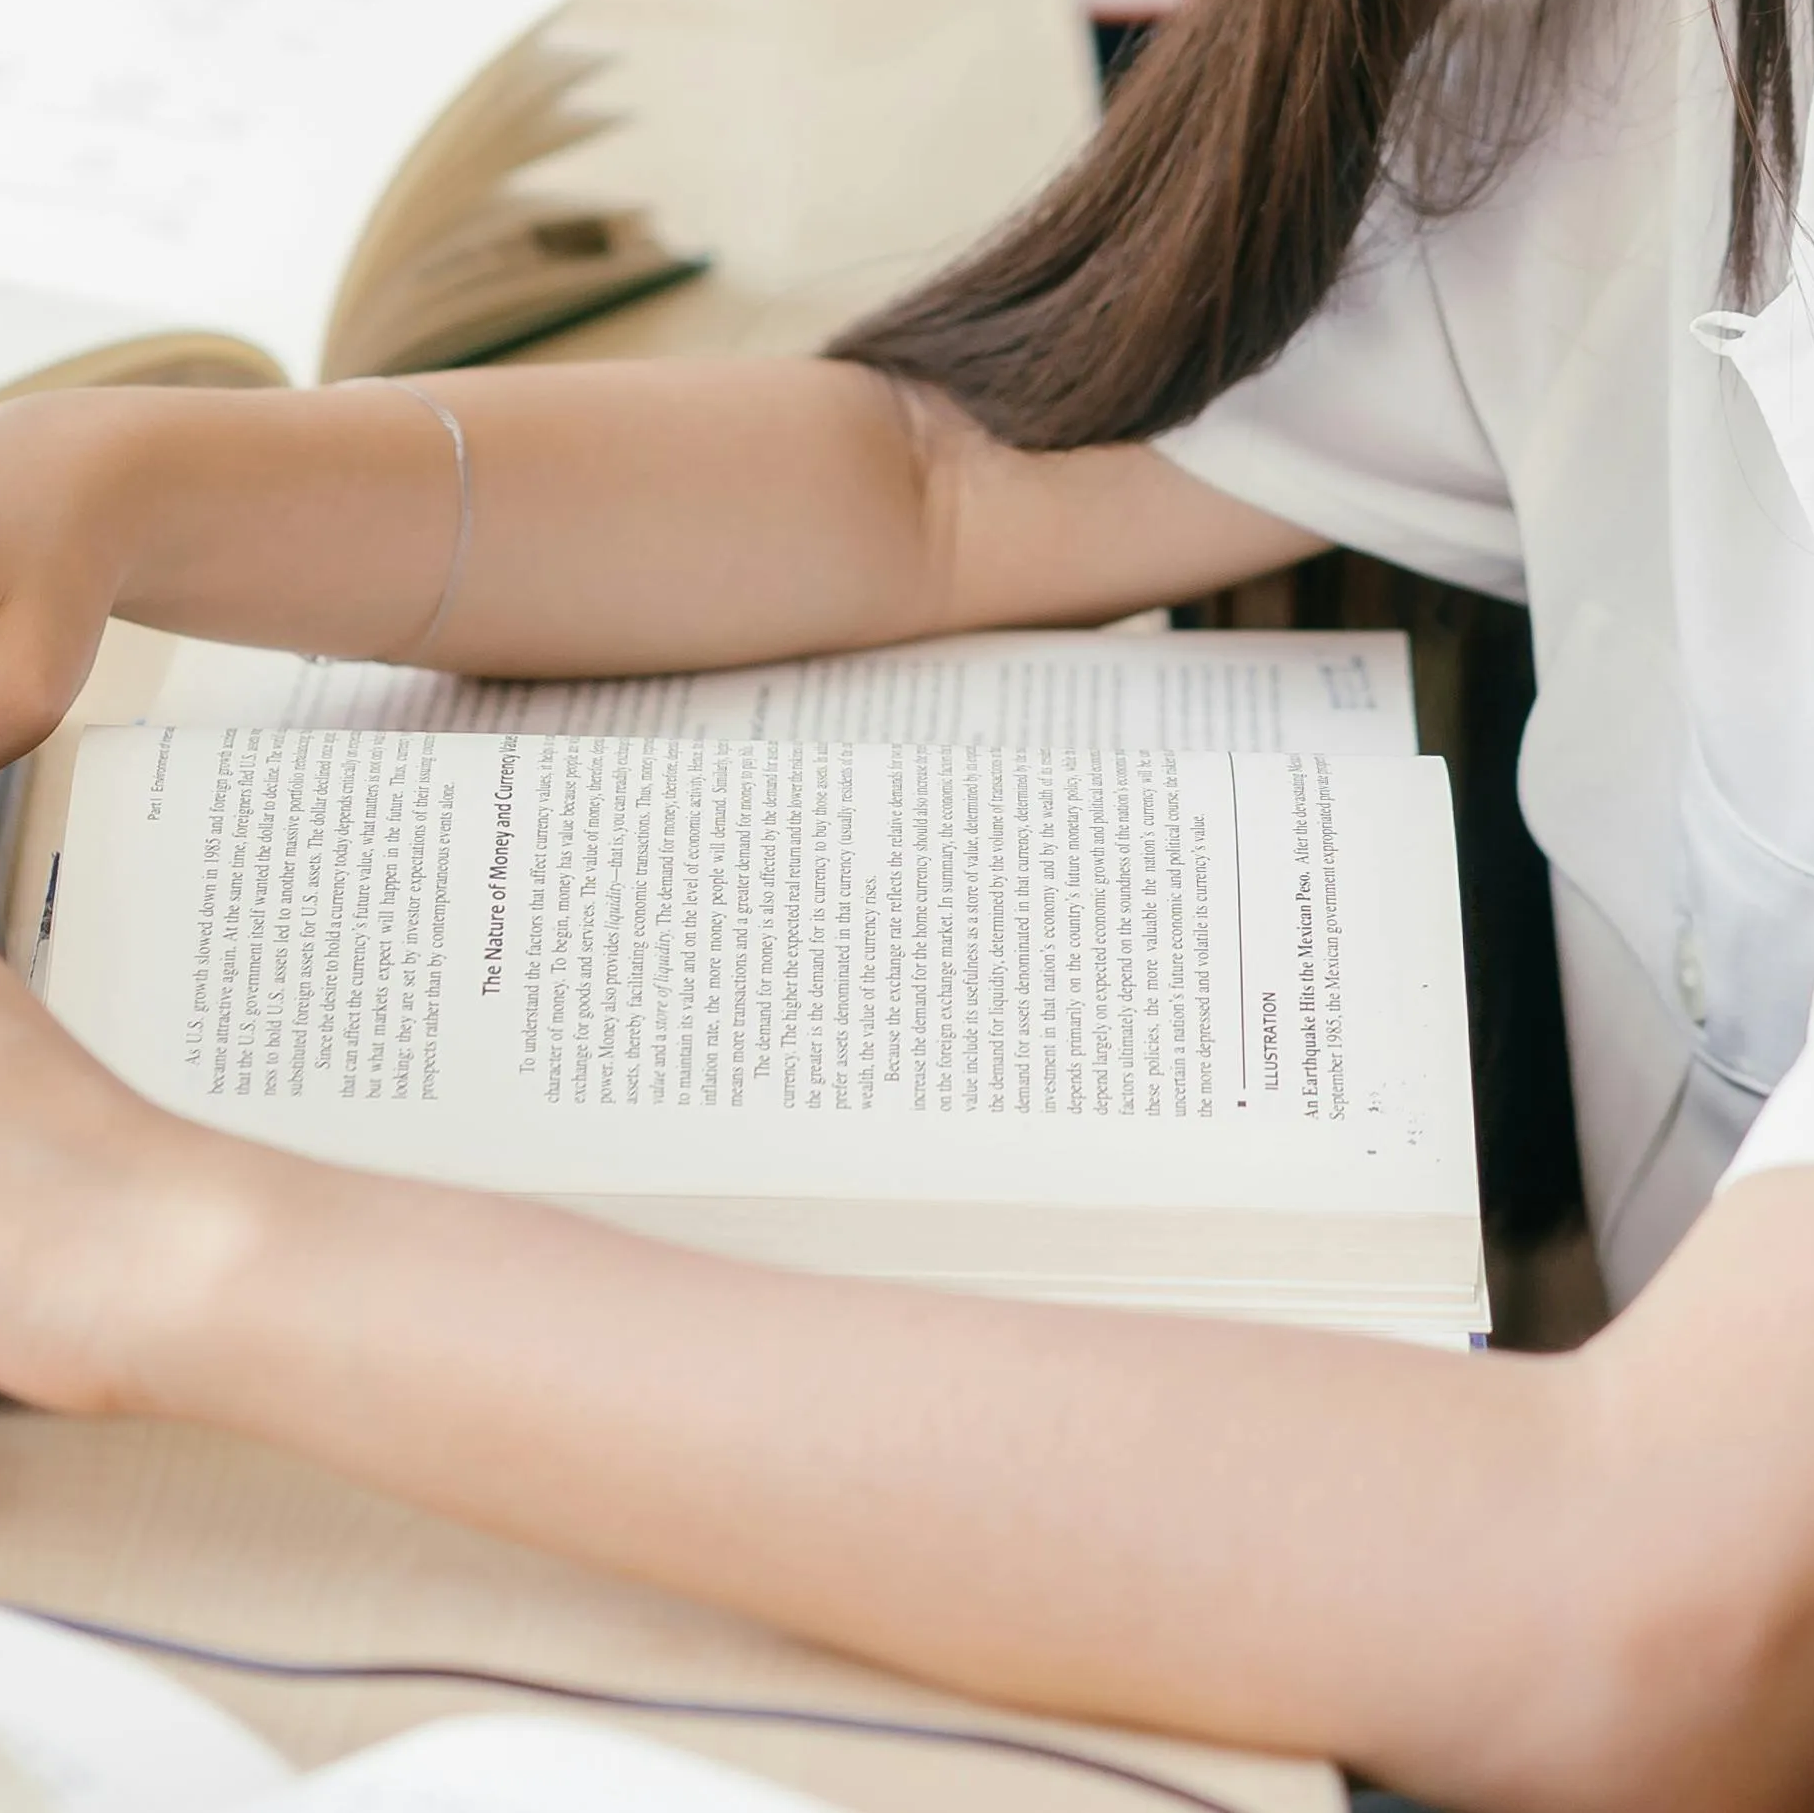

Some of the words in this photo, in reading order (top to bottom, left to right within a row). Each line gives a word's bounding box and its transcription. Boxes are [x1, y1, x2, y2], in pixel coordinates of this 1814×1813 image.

[217, 751, 234, 776] growth
[313, 761, 332, 796] declined
[494, 754, 519, 800] Currency
[209, 778, 232, 812] foreign
[437, 782, 455, 810] alone.
[536, 772, 555, 802] values,
[1036, 777, 1054, 786] of
[1314, 776, 1335, 802] private
[309, 797, 328, 826] dollar
[386, 791, 404, 822] future.
[494, 804, 512, 828] and
[710, 798, 727, 838] demand.
[1037, 789, 1054, 818] wealth
[1142, 788, 1158, 826] currency
[208, 816, 224, 834] and
[306, 828, 324, 849] The
[384, 827, 401, 842] the
[439, 812, 453, 844] events
[536, 806, 554, 850] currency
[837, 806, 856, 845] (usually
[1038, 823, 1055, 838] the
[1067, 805, 1083, 850] monetary
[1292, 820, 1308, 834] the
[1315, 803, 1338, 864] expropriated
[204, 838, 221, 862] 1985
[382, 847, 399, 858] in
[489, 831, 514, 880] Money
[709, 843, 726, 863] will
[1038, 842, 1059, 855] by
[1140, 831, 1156, 872] nation's
[1293, 836, 1310, 864] After
[202, 869, 219, 879] in
[308, 852, 322, 887] assets.
[379, 864, 401, 904] happen
[530, 854, 547, 884] affect
[839, 850, 855, 897] currency
[1038, 860, 1055, 880] and
[1064, 855, 1081, 887] future
[1190, 846, 1210, 902] currency's
[198, 884, 217, 917] down
[432, 847, 450, 948] contemporaneous
[488, 884, 506, 900] of
[529, 888, 546, 910] that
[708, 868, 729, 905] people
[860, 876, 877, 904] rises.
[1141, 877, 1157, 895] the
[1295, 872, 1311, 901] Peso.
[1322, 868, 1342, 934] government
[301, 892, 318, 916] U.S.
[835, 902, 851, 923] that
[1043, 885, 1059, 938] economy
[1192, 906, 1208, 918] its
[299, 920, 316, 938] for
[377, 911, 394, 934] will
[484, 905, 505, 960] Nature
[525, 915, 543, 956] factors
[710, 911, 727, 951] money
[834, 928, 851, 940] in
[864, 908, 880, 960] currency
[1064, 892, 1085, 948] country's
[1141, 902, 1158, 951] valuable
[1297, 905, 1313, 957] Mexican
[194, 922, 213, 965] slowed
[378, 938, 394, 980] expect
[1192, 922, 1209, 966] volatile
[299, 942, 315, 978] assets
[426, 952, 446, 967] by
[524, 962, 541, 980] the
[709, 958, 722, 988] more
[859, 964, 876, 983] the
[1039, 944, 1056, 992] nation's
[1065, 953, 1081, 971] the
[1146, 959, 1159, 990] more
[1298, 962, 1314, 981] the
[1323, 937, 1340, 989] Mexican
[192, 969, 210, 1013] growth
[424, 971, 441, 998] than
[482, 966, 500, 996] The
[833, 945, 850, 1025] denominated
[858, 986, 875, 1000] of
[1069, 978, 1081, 993] on
[1194, 970, 1210, 993] and
[292, 981, 315, 1026] foreign
[371, 986, 389, 1036] markets
[704, 995, 720, 1013] the
[1039, 998, 1056, 1020] that
[1143, 998, 1159, 1016] the
[1299, 986, 1315, 1011] Hits
[1325, 993, 1341, 1012] the
[187, 1018, 204, 1043] U.S.
[422, 1001, 439, 1037] rather
[522, 985, 540, 1052] understand
[706, 1020, 720, 1046] rate,
[859, 1004, 875, 1038] value
[1039, 1026, 1057, 1038] in
[1065, 999, 1085, 1056] primarily
[1195, 997, 1214, 1058] depressed
[1325, 1015, 1342, 1048] 1985,
[836, 1030, 849, 1067] assets
[858, 1042, 875, 1060] the
[1143, 1024, 1165, 1076] policies,
[1262, 992, 1278, 1090] ILLUSTRATION
[1300, 1016, 1321, 1096] Earthquake
[186, 1049, 202, 1065] As
[289, 1030, 307, 1096] substituted
[367, 1042, 385, 1072] what
[422, 1041, 439, 1100] prospects
[520, 1058, 537, 1072] To
[366, 1078, 382, 1098] but
[700, 1052, 718, 1105] inflation
[831, 1071, 851, 1109] prefer
[857, 1064, 875, 1109] wealth,
[1043, 1045, 1057, 1113] investment
[1066, 1062, 1085, 1114] depends
[1200, 1062, 1212, 1094] more
[1327, 1053, 1346, 1120] September
[1145, 1083, 1161, 1116] these
[1197, 1098, 1213, 1117] the
[1304, 1100, 1319, 1119] An
